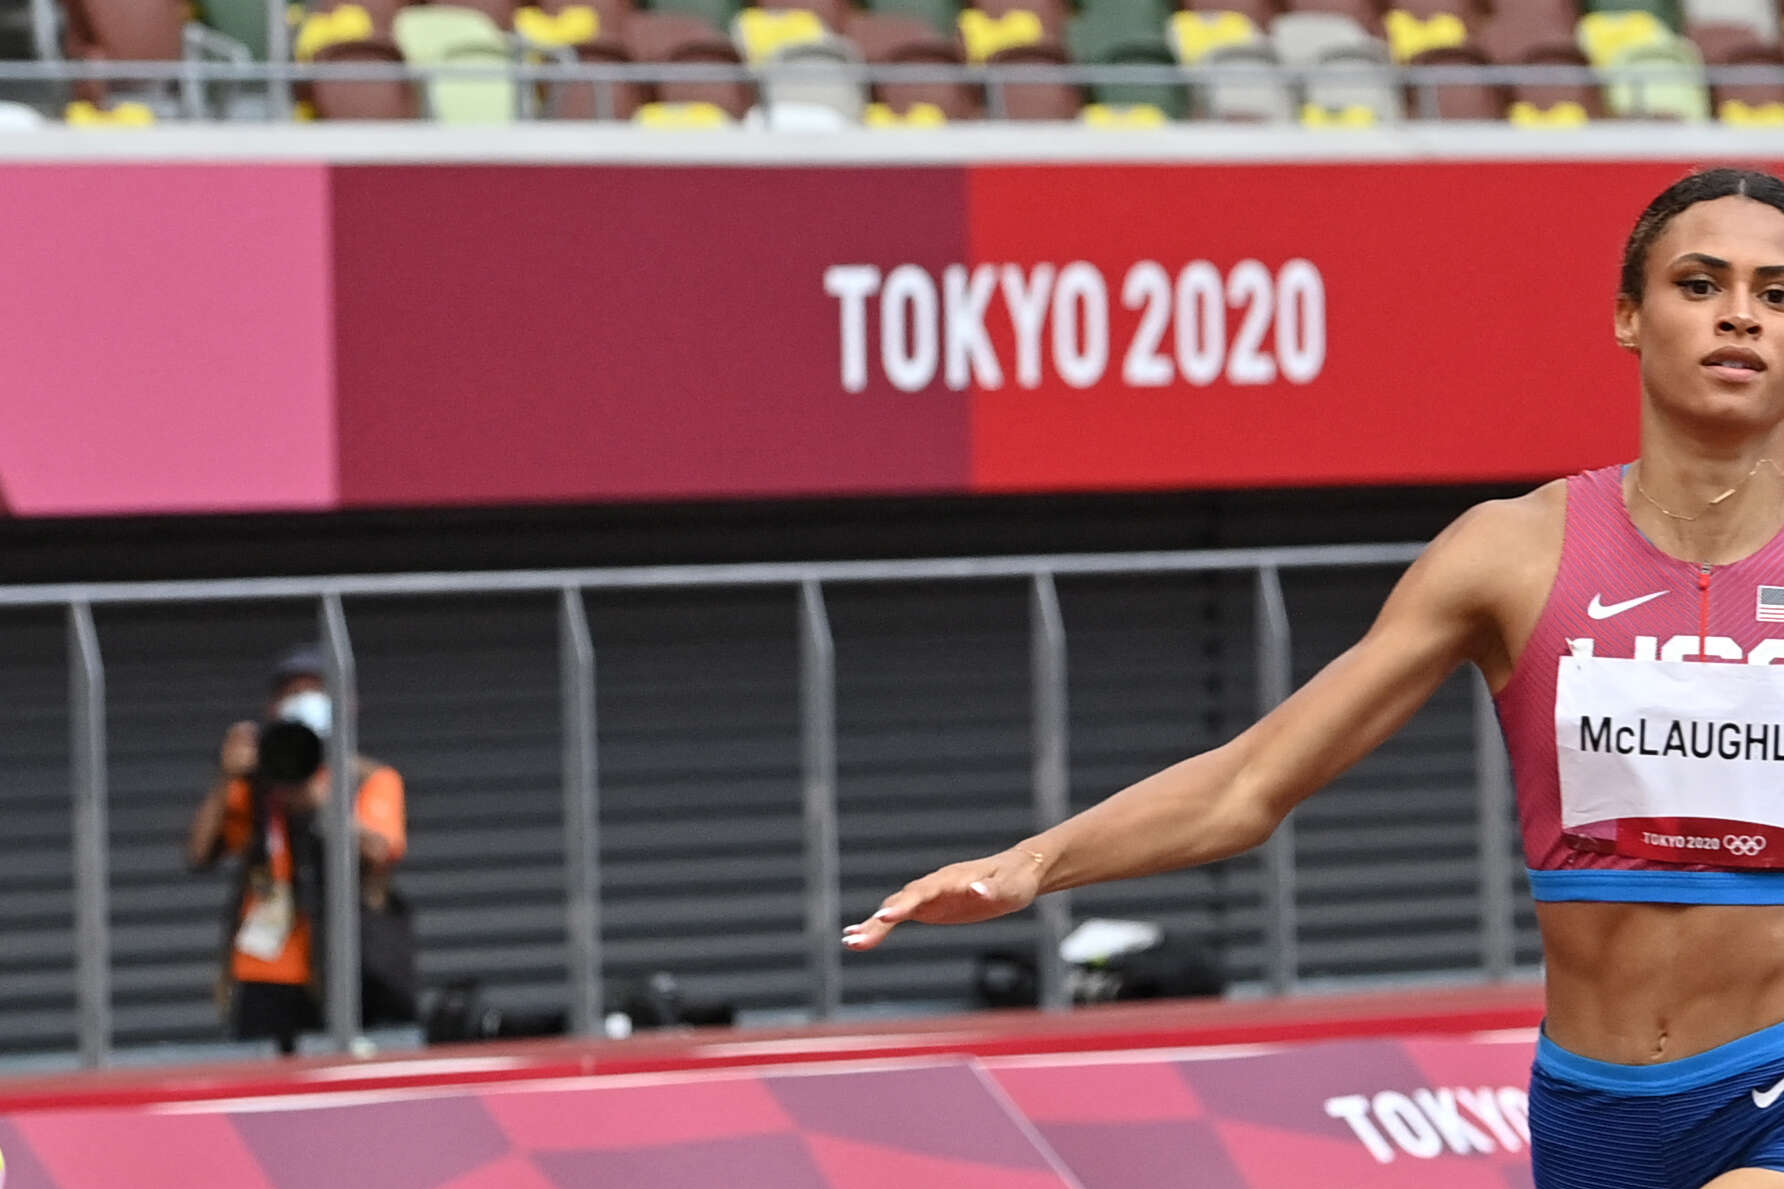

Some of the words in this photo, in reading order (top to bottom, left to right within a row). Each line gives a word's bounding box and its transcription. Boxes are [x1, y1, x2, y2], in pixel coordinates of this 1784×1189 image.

[824, 261, 1109, 394] TOKYO
[1121, 258, 1327, 388] 2020
[1642, 832, 1685, 848] TOKYO
[1686, 836, 1720, 850] 2020
